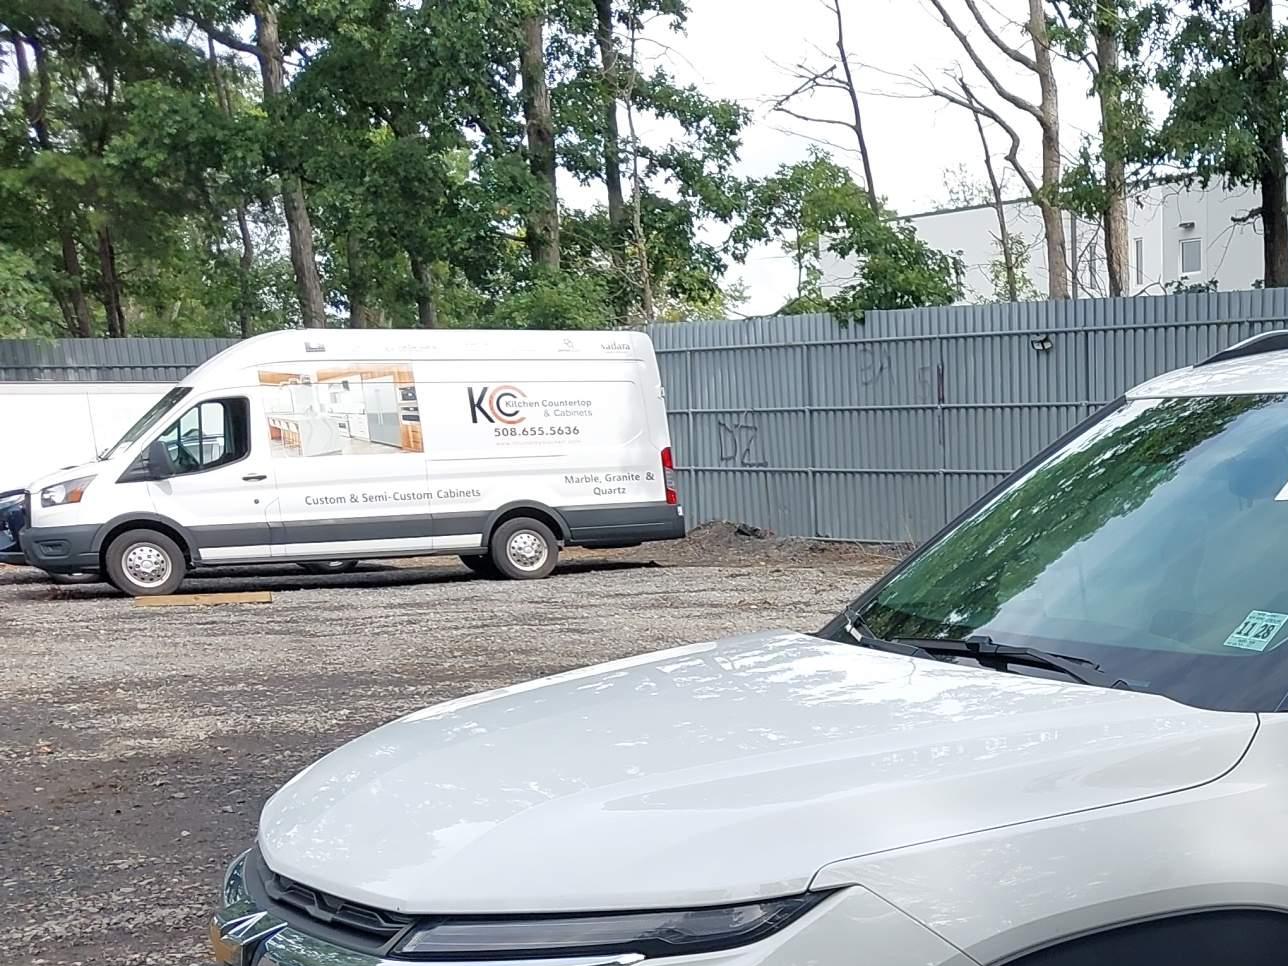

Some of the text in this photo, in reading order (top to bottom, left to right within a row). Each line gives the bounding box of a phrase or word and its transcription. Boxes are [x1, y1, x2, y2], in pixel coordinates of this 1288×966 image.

[505, 399, 592, 408] Kitchen Countertop
[553, 408, 593, 417] Cabinets
[494, 426, 580, 437] 508.655.5636
[564, 471, 655, 484] Marble, Granite &
[304, 488, 481, 505] Custom & Semi-Custom Cabinets
[593, 487, 626, 496] Quartz
[1236, 621, 1276, 639] 11 28
